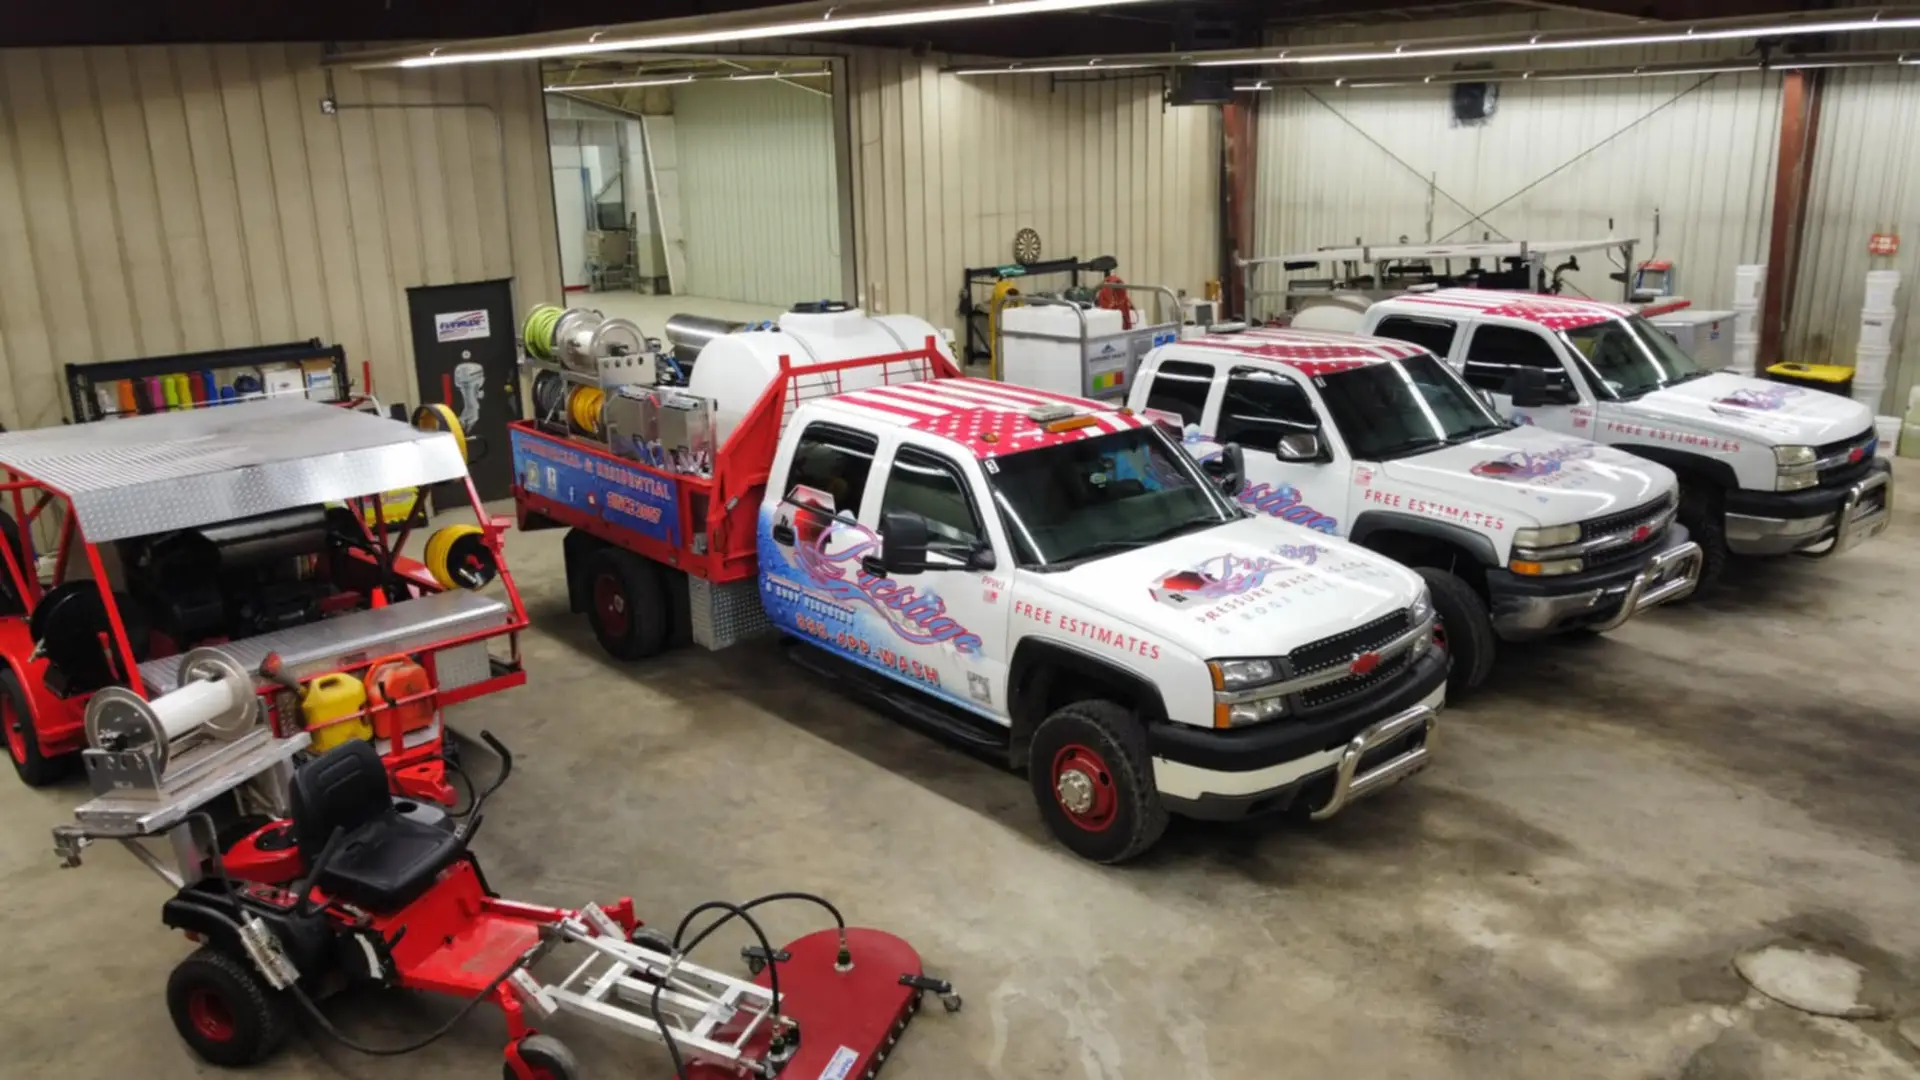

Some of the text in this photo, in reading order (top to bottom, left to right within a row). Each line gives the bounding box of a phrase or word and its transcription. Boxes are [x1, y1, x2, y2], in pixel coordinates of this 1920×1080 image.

[1364, 489, 1504, 530] FREE ESTIMATES
[1015, 600, 1161, 661] FREE ESTIMATES
